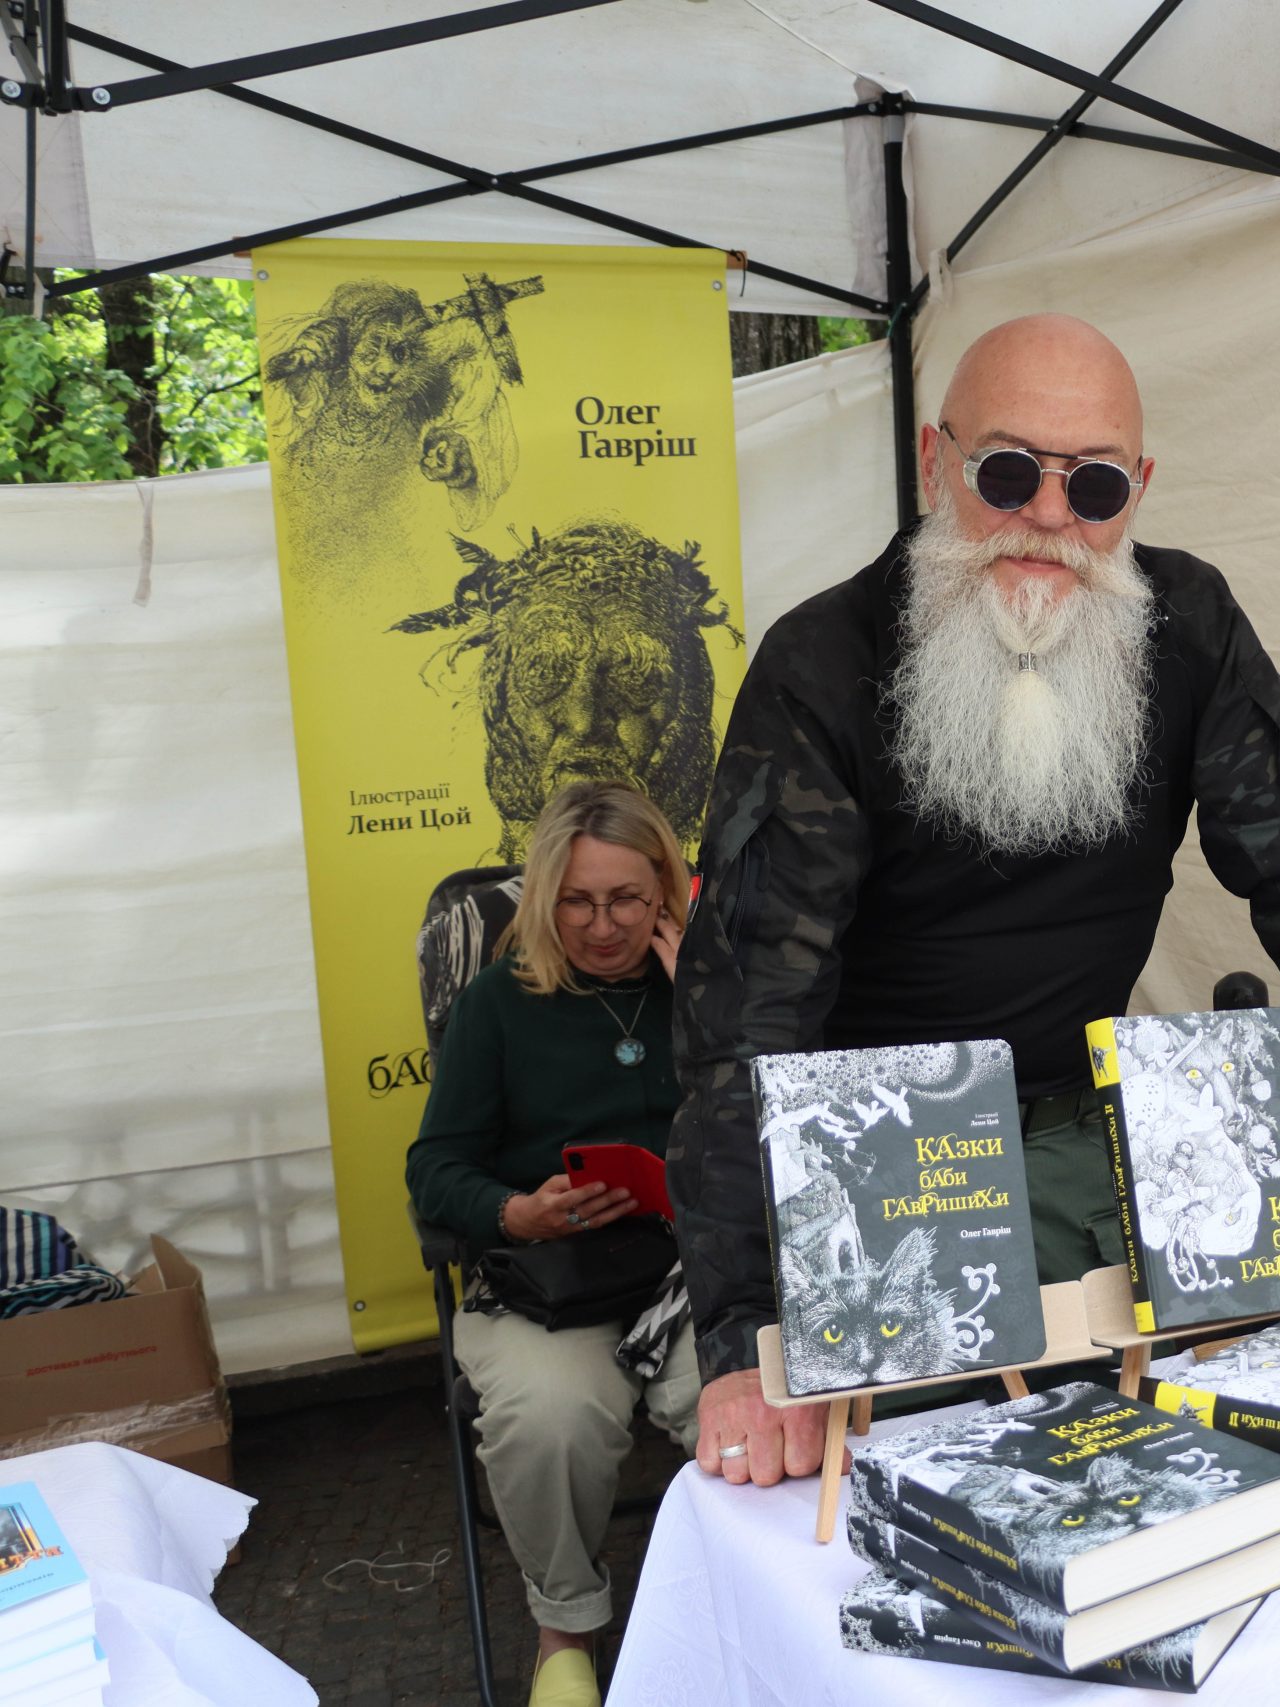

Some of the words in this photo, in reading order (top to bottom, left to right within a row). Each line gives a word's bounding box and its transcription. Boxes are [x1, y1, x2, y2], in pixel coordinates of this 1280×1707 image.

[575, 396, 660, 426] Олег
[578, 428, 698, 467] Гавріш
[349, 782, 451, 806] Ілюстрації
[346, 814, 413, 836] Лени
[419, 806, 472, 832] Цой
[960, 1229, 982, 1239] Олег
[982, 1225, 1012, 1238] Гавріш
[933, 1634, 961, 1646] Гавріш
[961, 1639, 982, 1649] Олег
